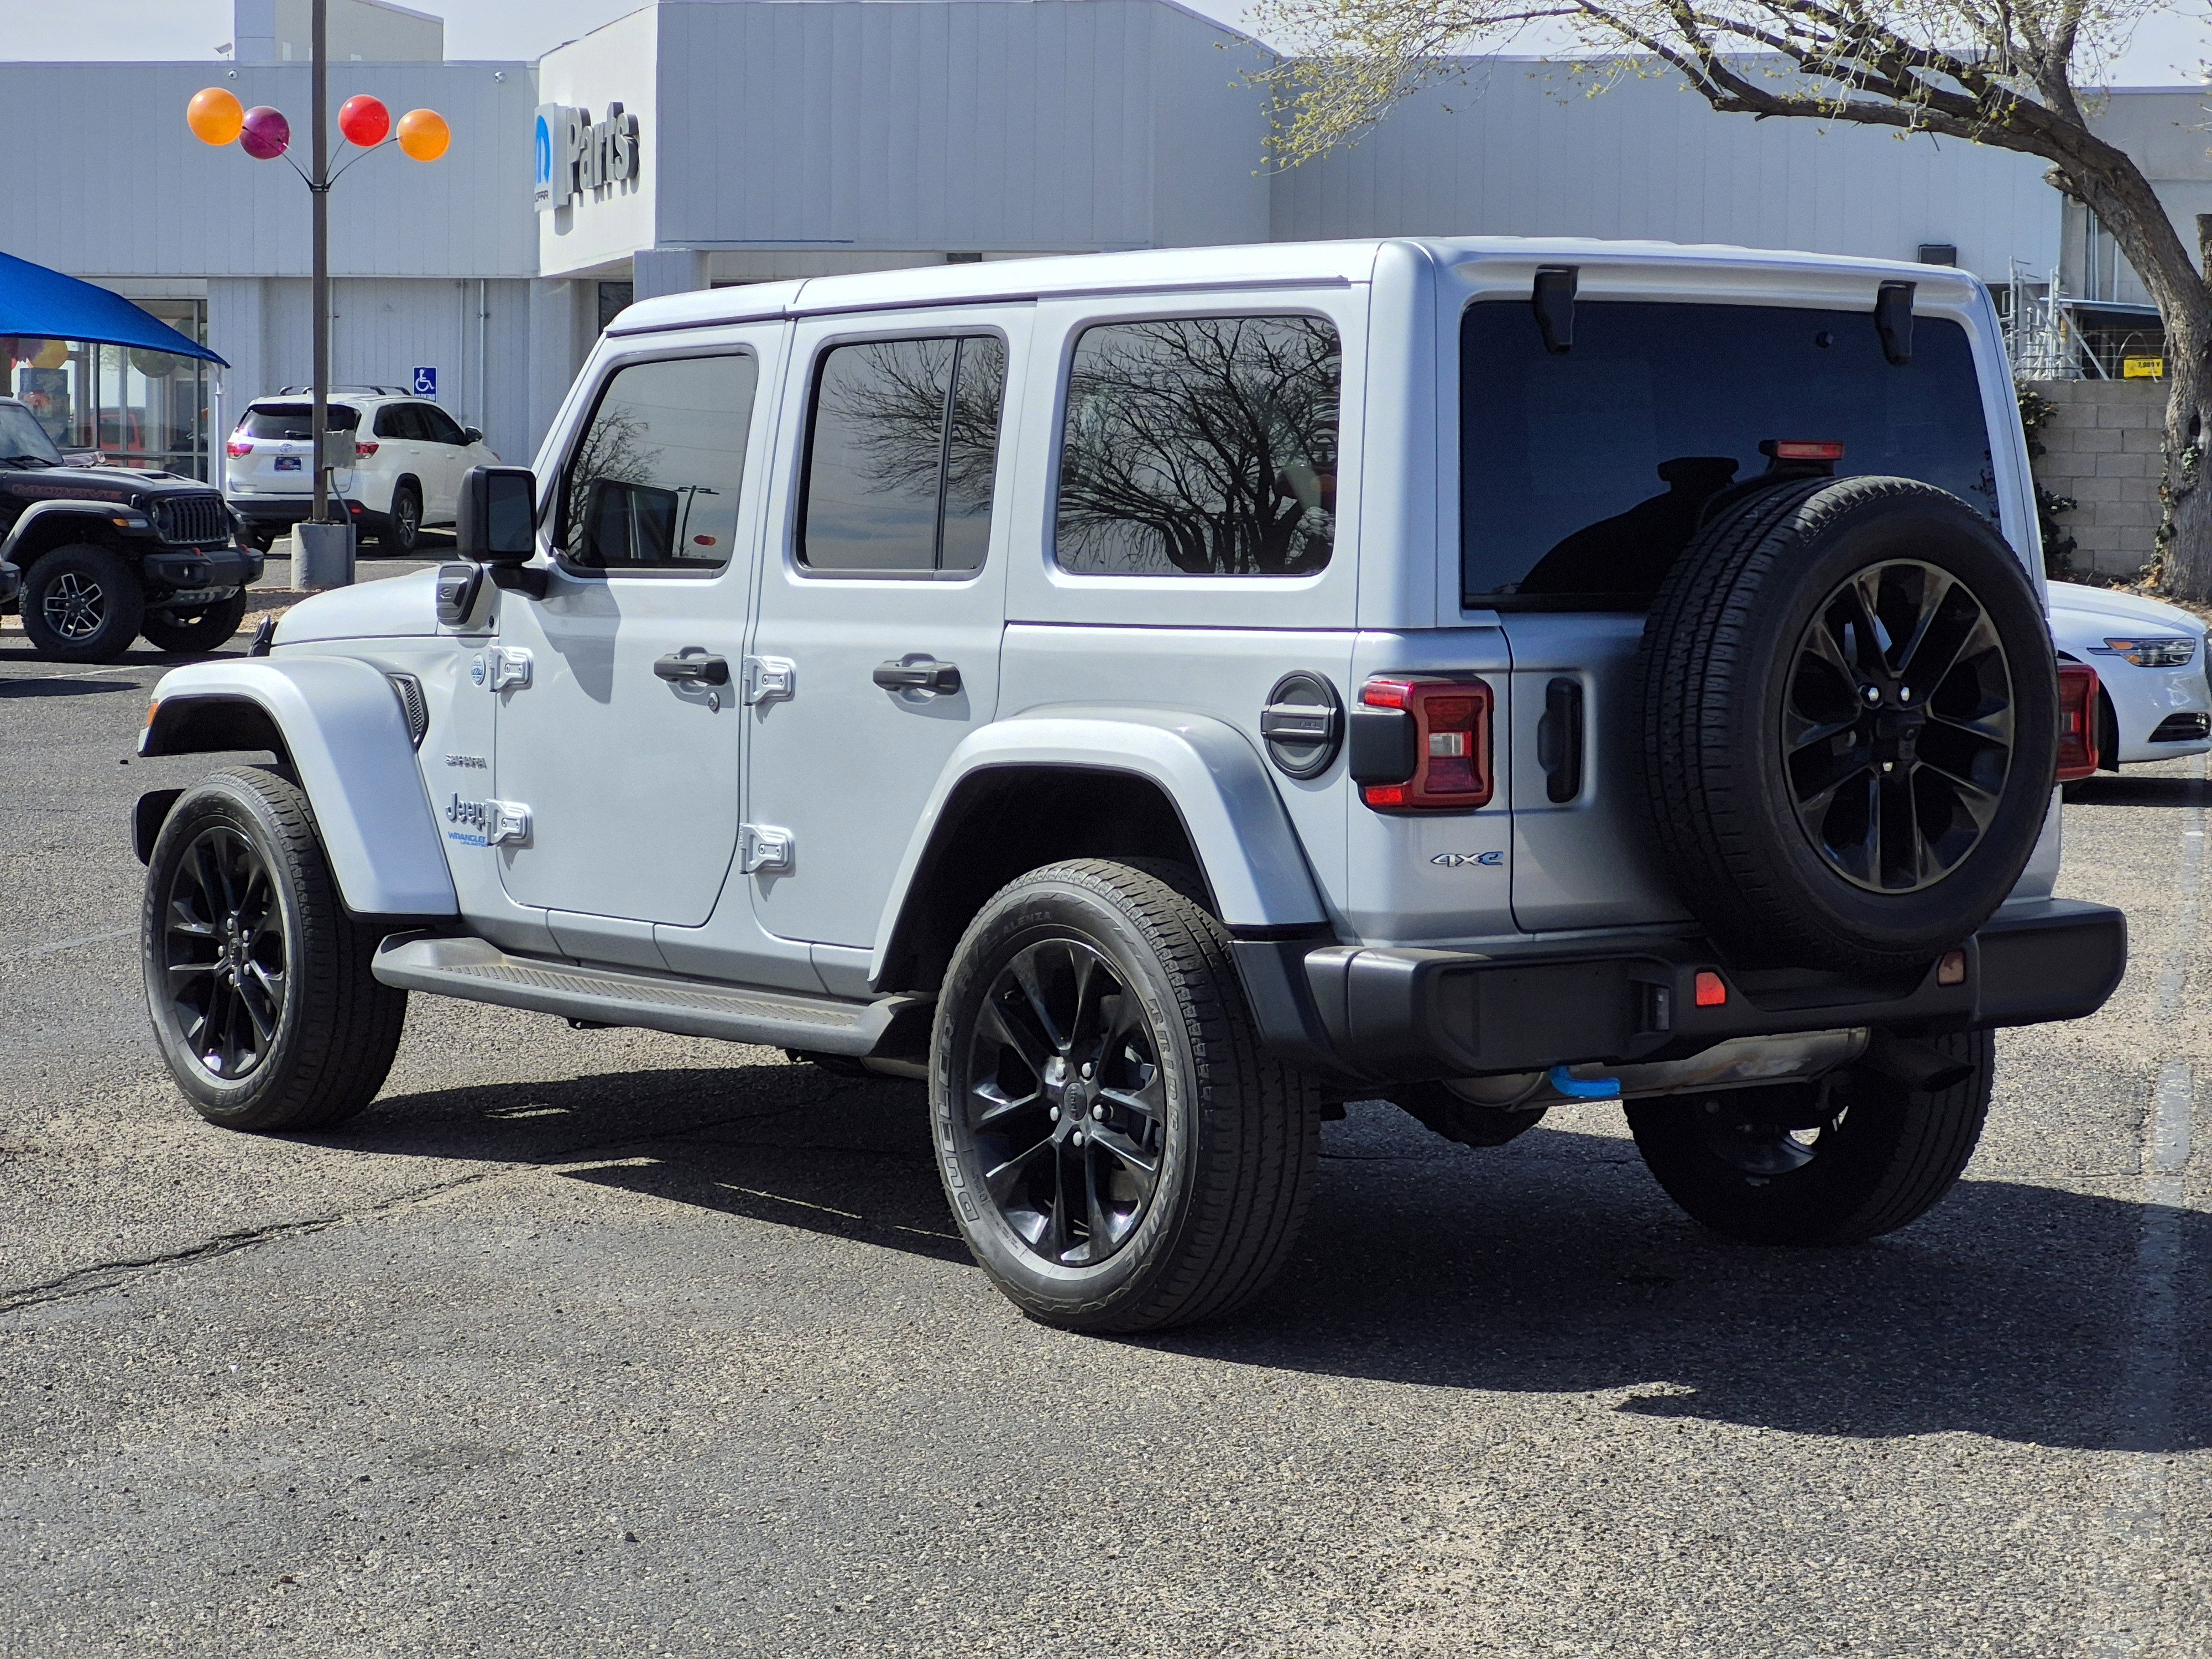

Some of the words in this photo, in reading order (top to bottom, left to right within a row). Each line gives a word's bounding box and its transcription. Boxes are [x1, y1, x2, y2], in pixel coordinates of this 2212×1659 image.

[566, 102, 639, 195] Parts
[445, 755, 487, 769] SAHARA
[445, 792, 486, 832] Jeep
[937, 1013, 980, 1223] DUELER
[1003, 911, 1052, 935] ALENZA
[1125, 997, 1179, 1272] BRIDGESTONE
